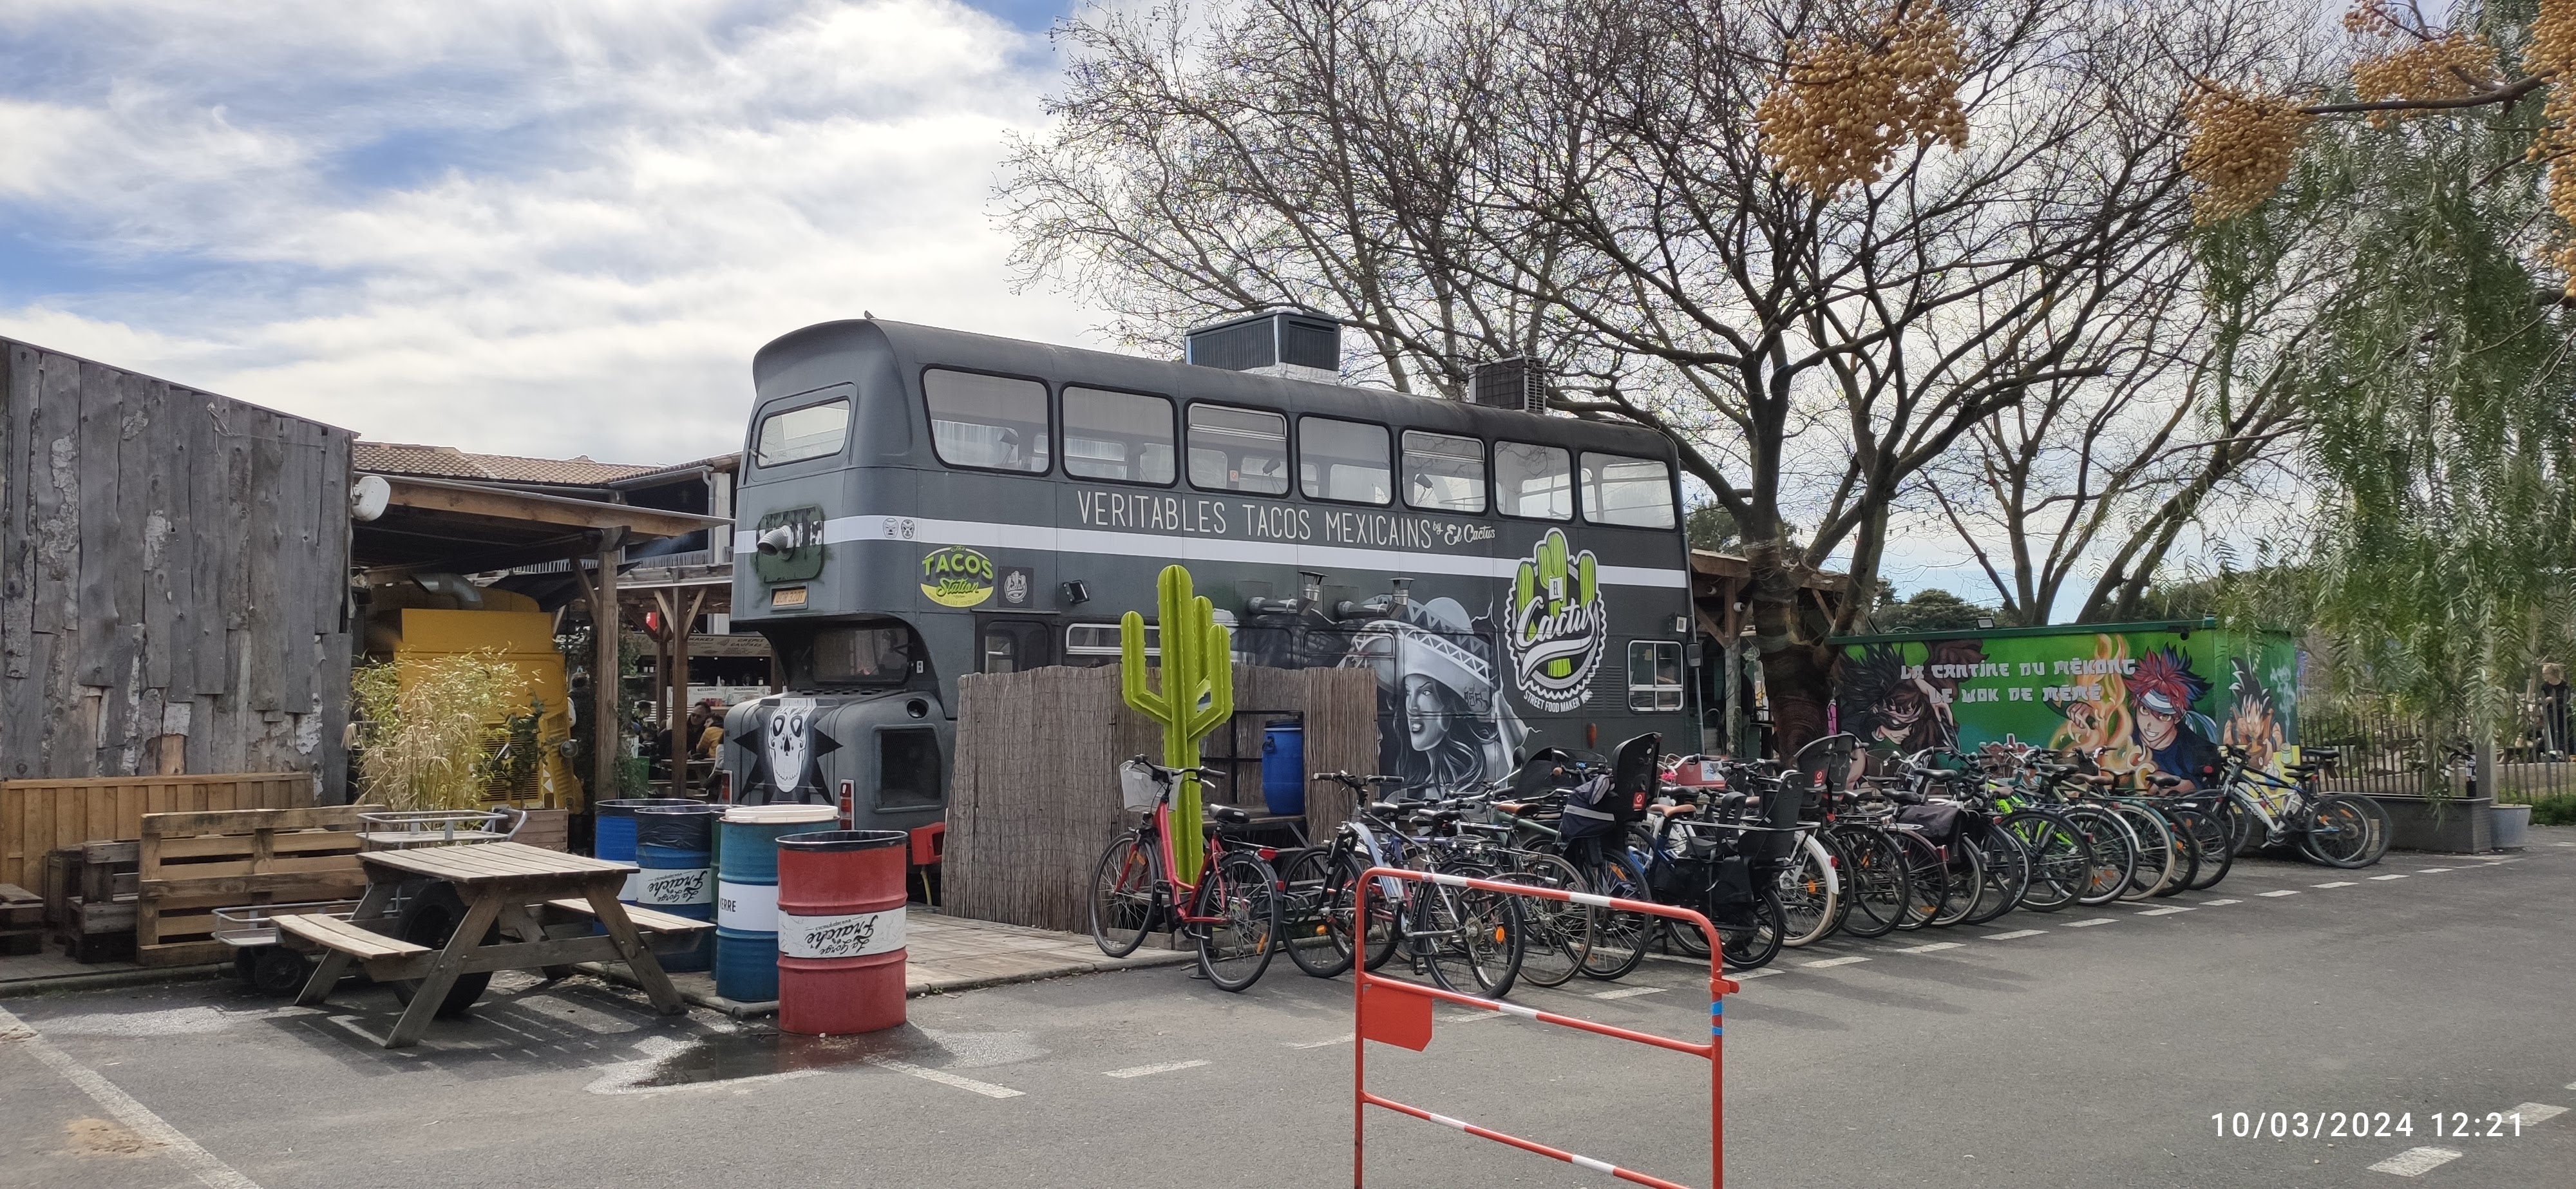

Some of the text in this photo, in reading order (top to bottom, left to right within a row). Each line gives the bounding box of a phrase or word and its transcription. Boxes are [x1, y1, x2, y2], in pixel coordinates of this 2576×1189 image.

[1077, 490, 1495, 548] VERITABLES TACOS MEXICAINS by El Cactus
[922, 553, 993, 580] TACOS
[936, 577, 979, 597] Station
[1516, 596, 1595, 647] Cactus
[1900, 664, 1924, 680] LA
[1931, 660, 2010, 679] CANTINE
[2019, 661, 2045, 676] DU
[1524, 689, 1581, 713] STREET FOOD MAKER
[1931, 687, 1954, 704] LE
[1961, 687, 2000, 703] WOK
[2008, 687, 2034, 701] DE
[657, 889, 699, 903] La Gorge
[819, 938, 870, 955] La Gorge
